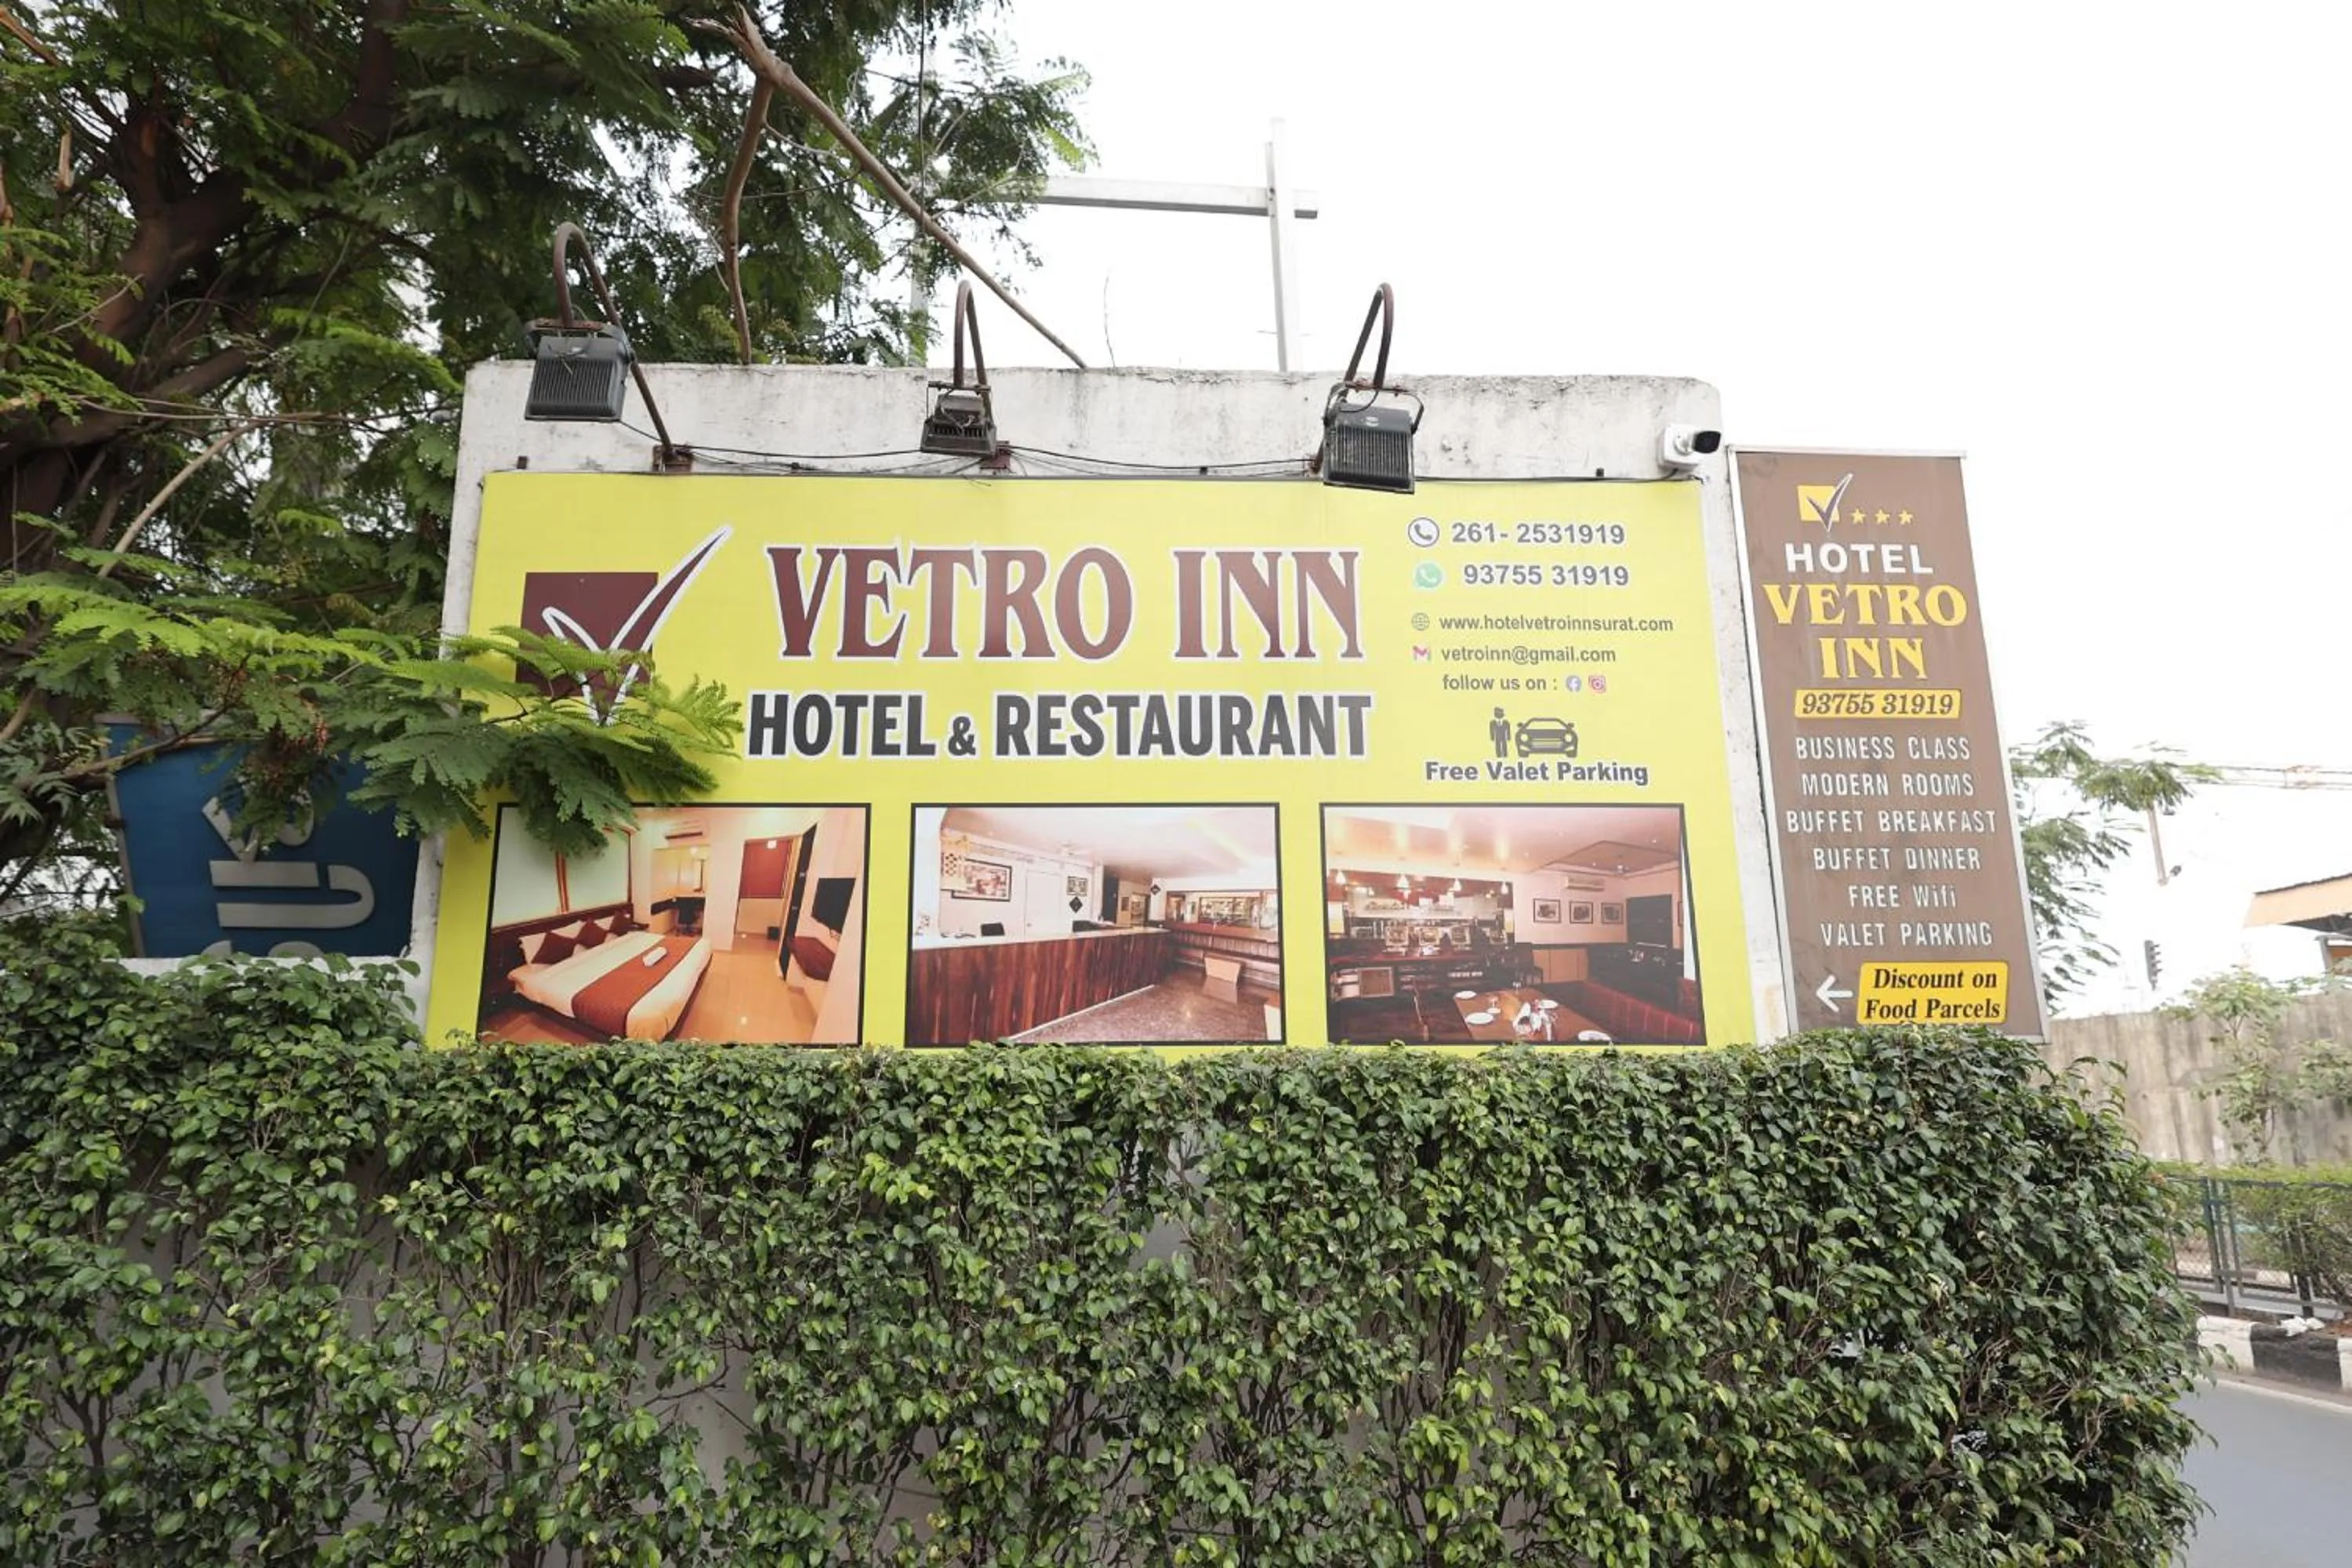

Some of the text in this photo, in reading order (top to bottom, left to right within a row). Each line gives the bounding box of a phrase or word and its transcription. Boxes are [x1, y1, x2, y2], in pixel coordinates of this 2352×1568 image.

[1517, 524, 1624, 544] 2531919
[1785, 543, 1933, 573] HOTEL
[1464, 564, 1628, 586] 93755 31919
[766, 547, 1365, 661] VETRO INN
[1762, 583, 1967, 626] VETRO
[1439, 615, 1673, 632] www.hotelvetroinnsurat.com
[1442, 646, 1616, 665] vetroinn@gmail.com
[1819, 637, 1928, 679] INN
[1443, 675, 1494, 691] follow
[1501, 678, 1519, 690] us
[1526, 678, 1546, 690] on
[1803, 694, 1952, 715] 93755 31919
[750, 694, 1372, 757] HOTEL & RESTAURANT
[1796, 736, 1970, 760] BUSINESS CLASS
[1426, 762, 1648, 786] Free Valet Parking
[1802, 773, 1973, 797] MODERN ROOMS
[1787, 810, 1996, 833] BUFFET BREAKFAST
[1813, 848, 1980, 870] BUFFET DINNER
[1849, 885, 1956, 908] FREE Wifi
[1820, 922, 1992, 946] VALET PARKING
[1874, 968, 1997, 989] Discount on
[1865, 999, 2000, 1019] Food Parcels
